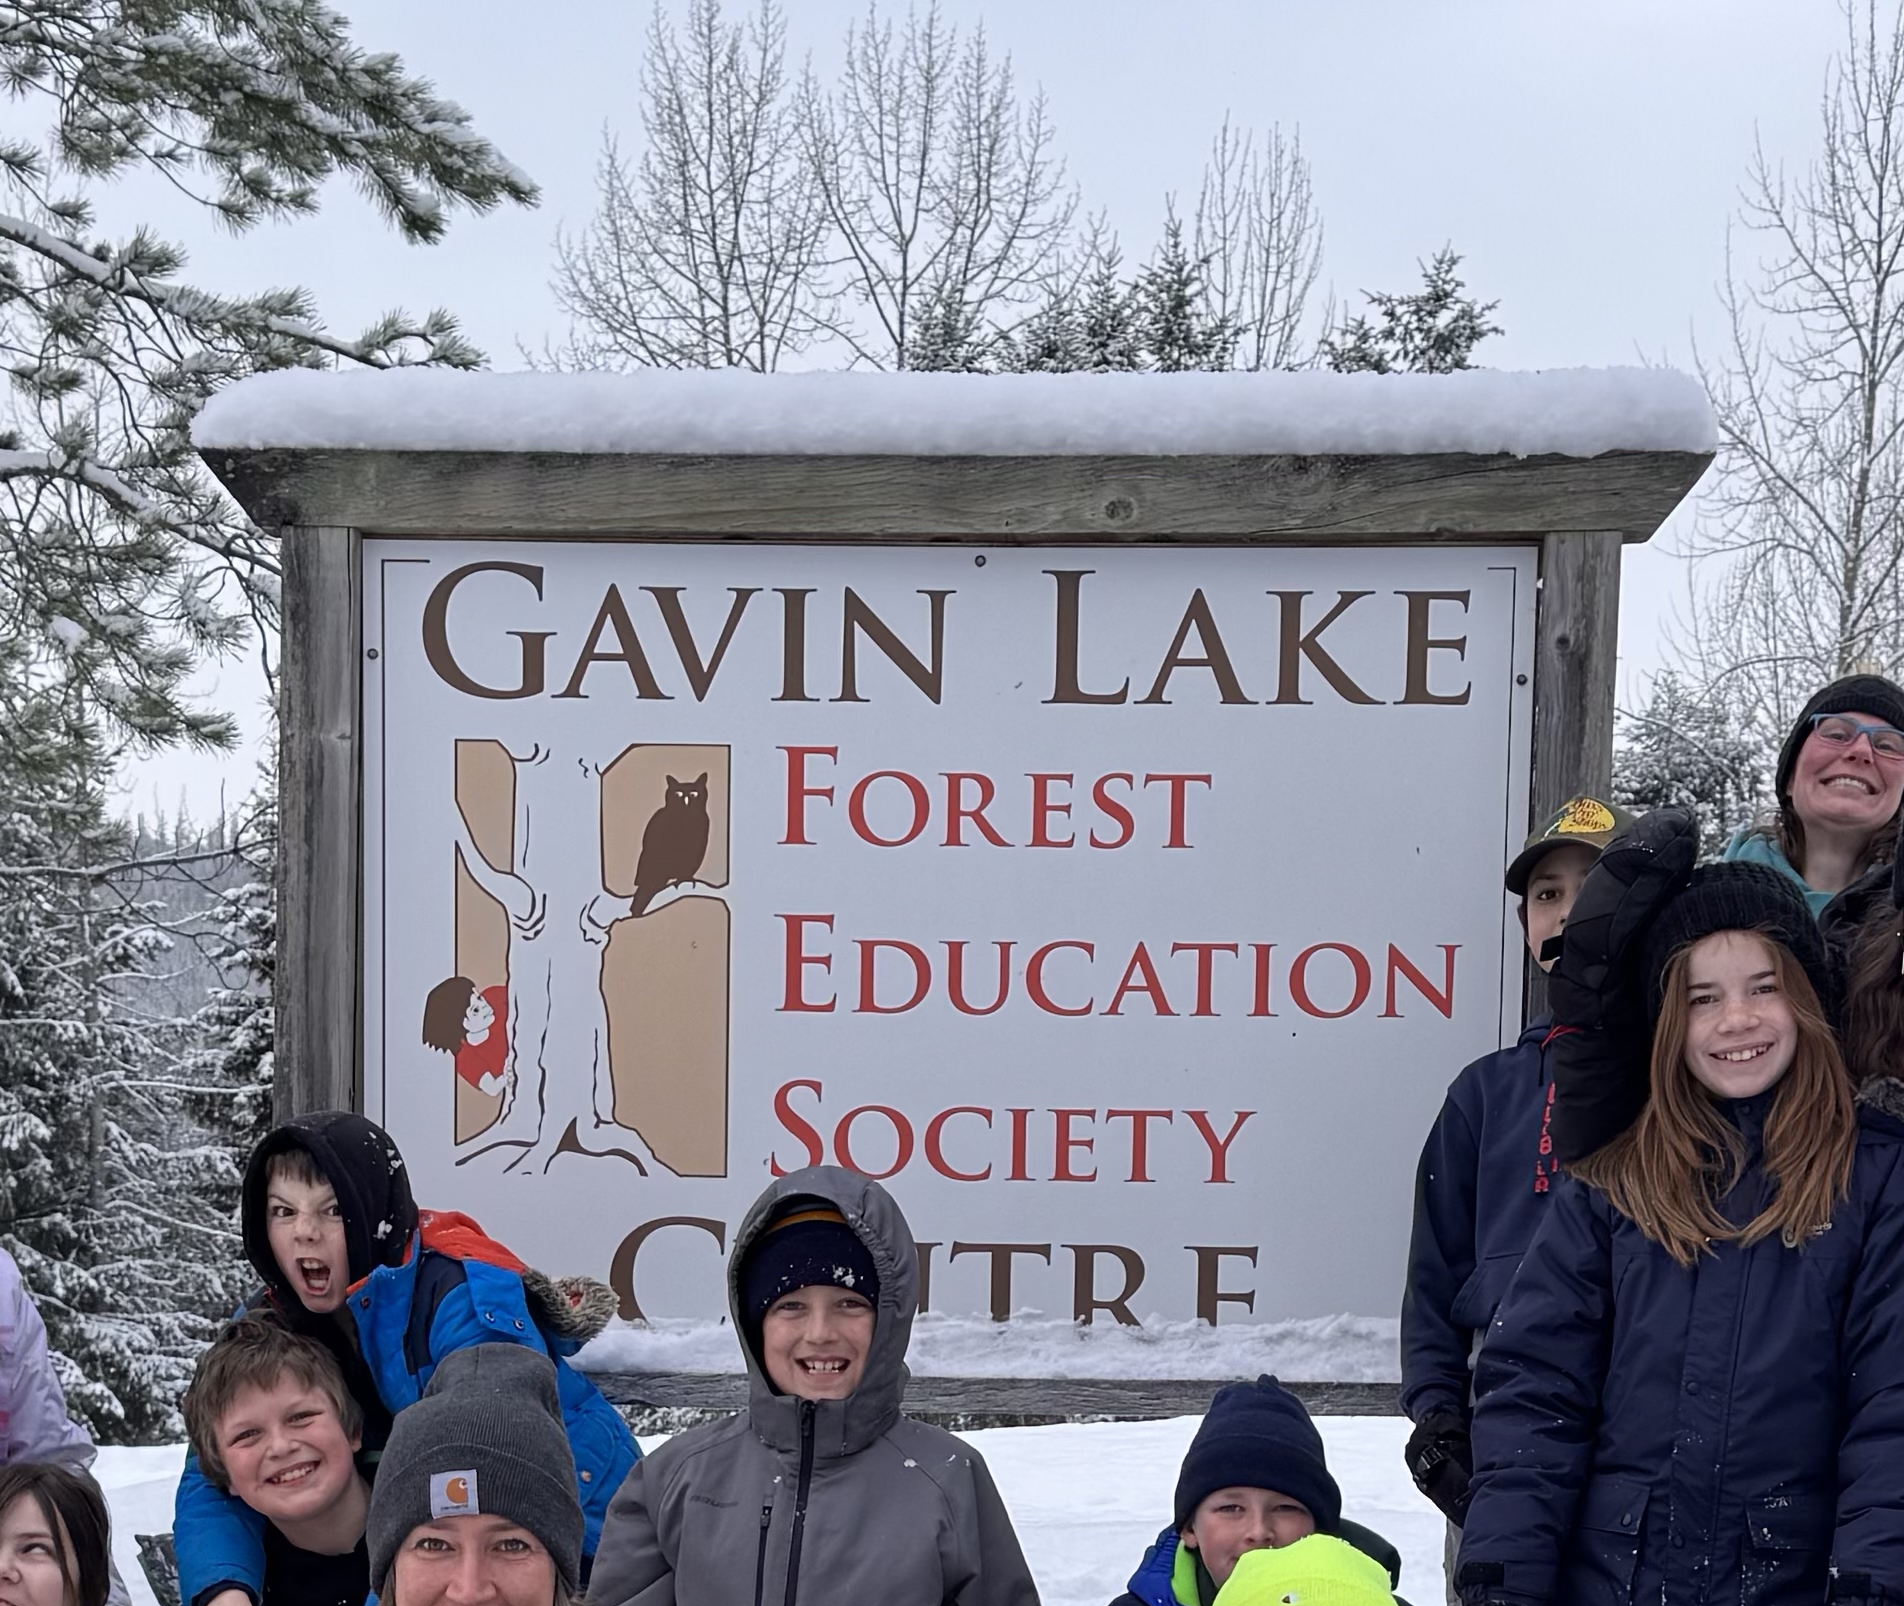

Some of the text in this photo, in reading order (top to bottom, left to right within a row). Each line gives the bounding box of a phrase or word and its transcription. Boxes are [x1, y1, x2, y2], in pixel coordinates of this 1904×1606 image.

[421, 560, 1474, 707] GAVIN LAKE
[777, 745, 1214, 850] FOREST
[774, 912, 1463, 1020] EDUCATION
[770, 1078, 1258, 1184] SOCIETY
[609, 1214, 1260, 1328] CTRE
